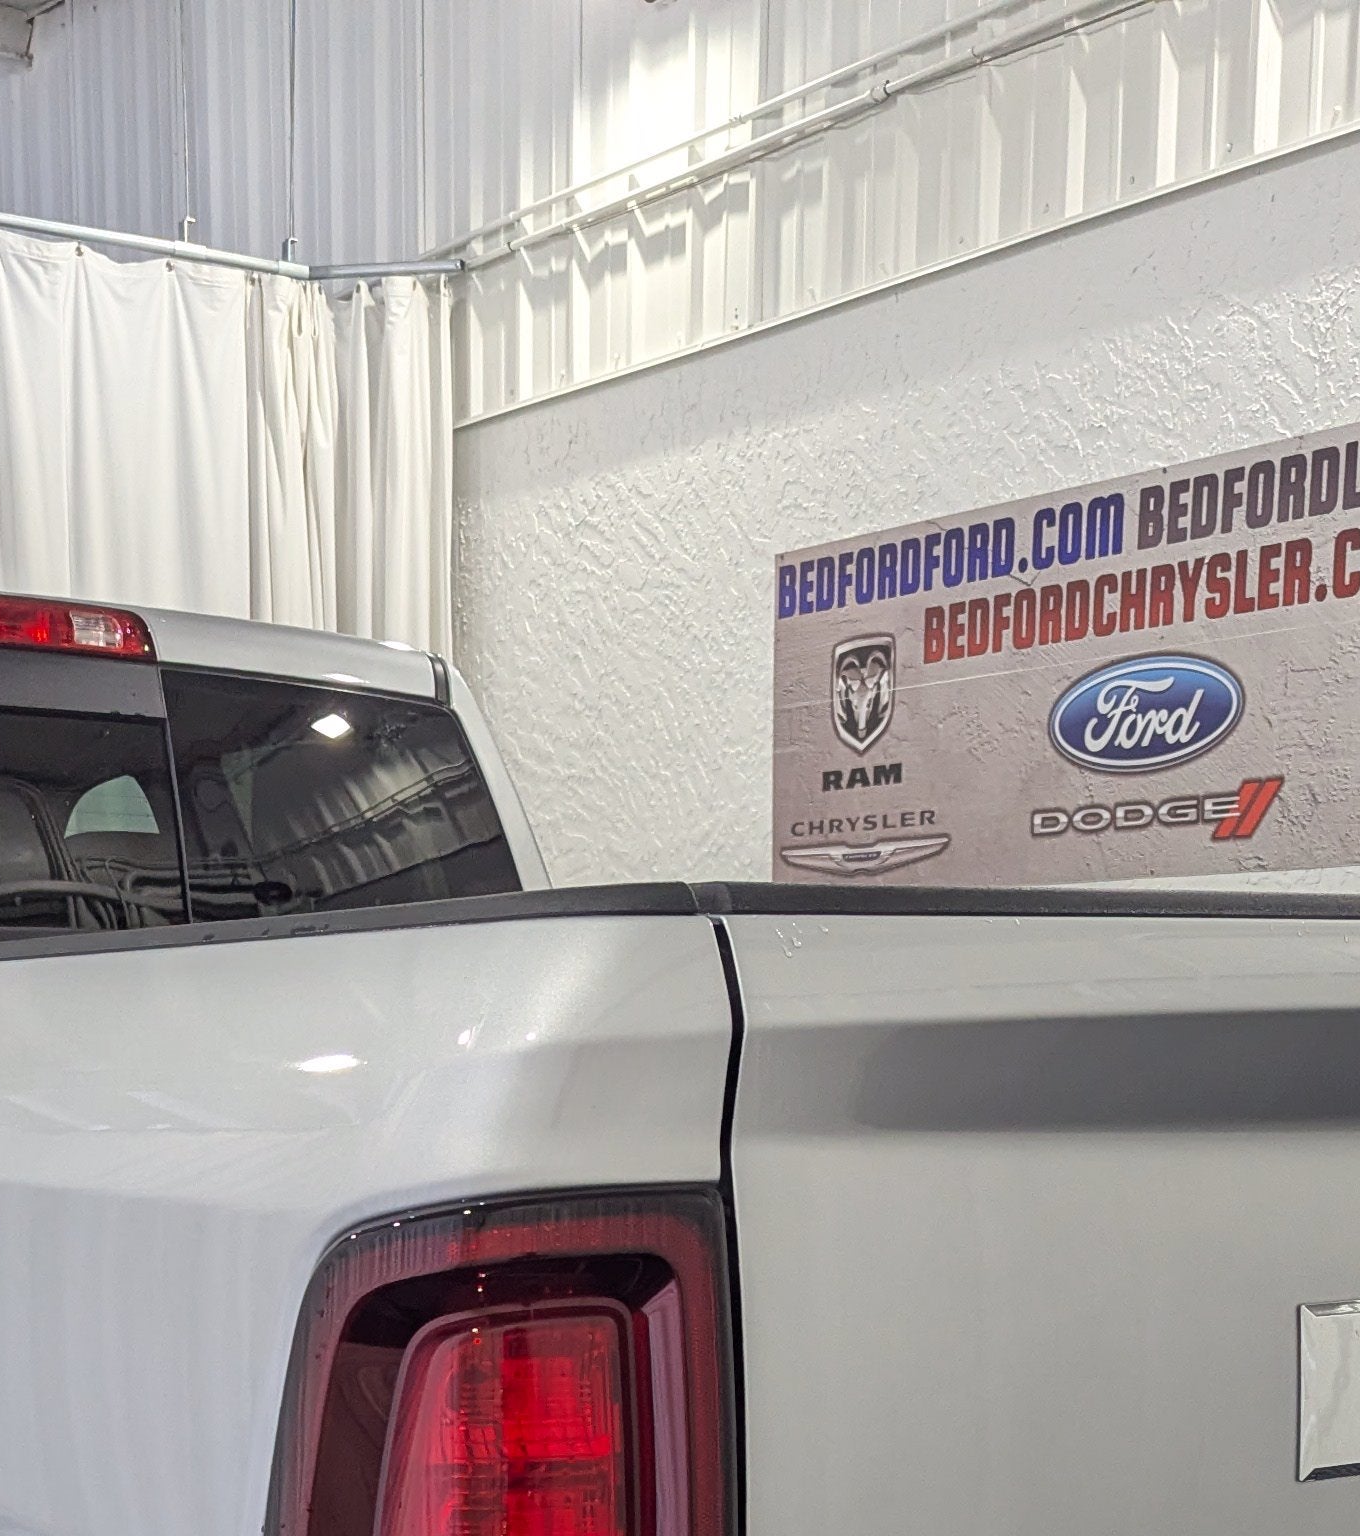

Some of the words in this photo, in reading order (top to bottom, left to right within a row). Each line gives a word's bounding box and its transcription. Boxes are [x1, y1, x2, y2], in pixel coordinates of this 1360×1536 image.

[777, 492, 1125, 619] BEDFORDFORD.COM
[1083, 675, 1203, 752] Ford
[822, 763, 903, 792] RAM
[790, 809, 936, 837] CHRYSLER
[1030, 794, 1242, 838] DODGE
